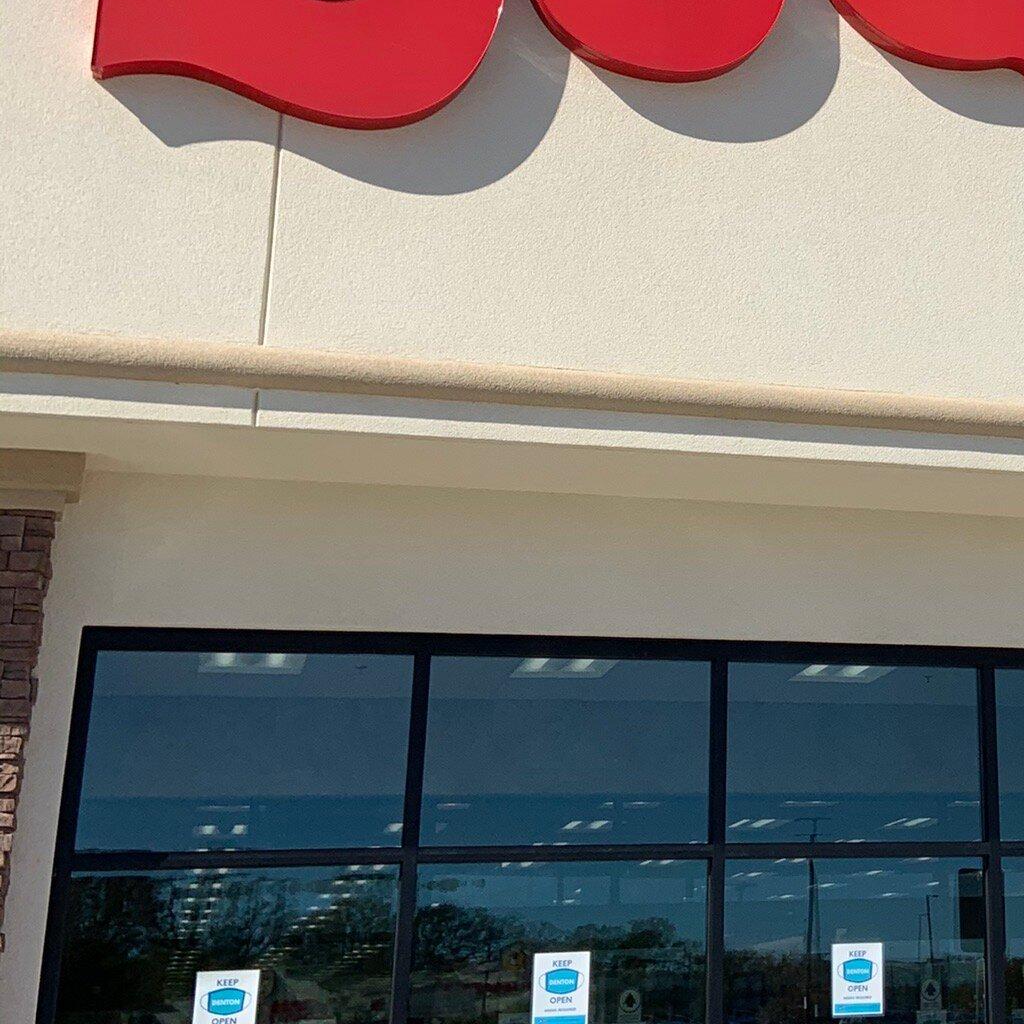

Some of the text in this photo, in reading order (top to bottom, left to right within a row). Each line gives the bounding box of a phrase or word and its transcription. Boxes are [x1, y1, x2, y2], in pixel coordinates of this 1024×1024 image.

[552, 959, 572, 967] KEEP
[216, 978, 239, 986] KEEP
[211, 998, 240, 1006] DENTON
[549, 996, 573, 1004] OPEN
